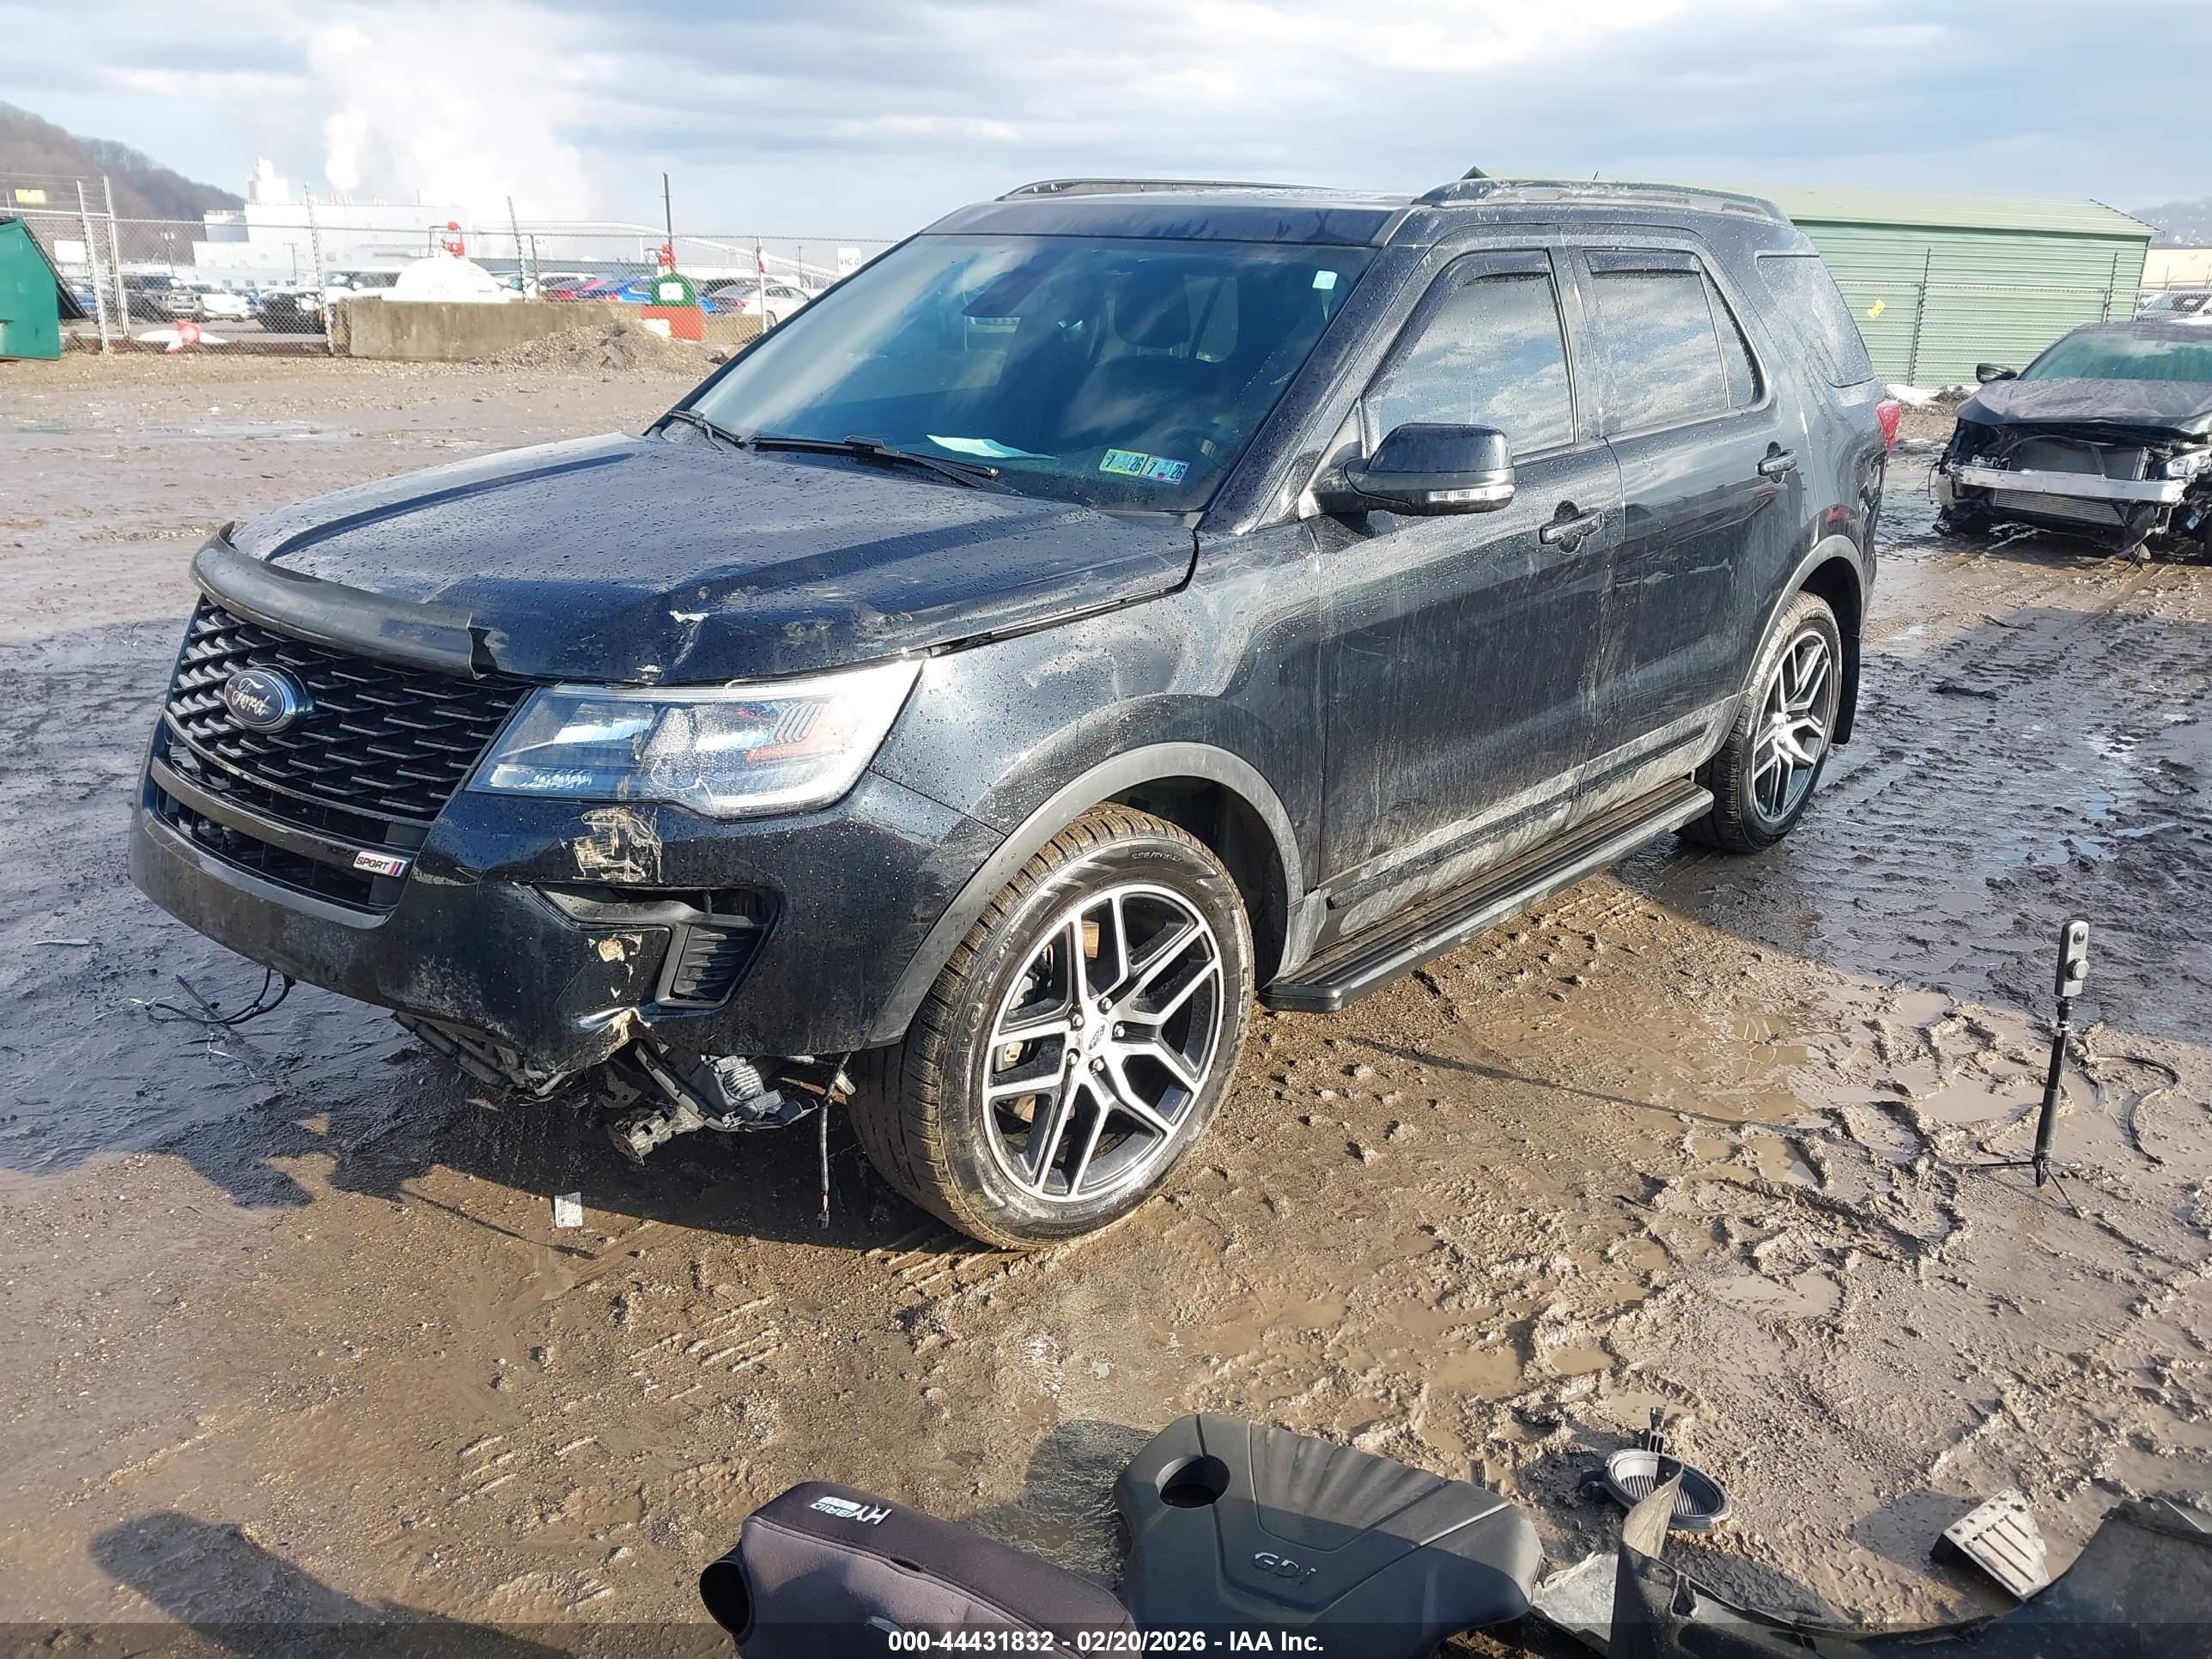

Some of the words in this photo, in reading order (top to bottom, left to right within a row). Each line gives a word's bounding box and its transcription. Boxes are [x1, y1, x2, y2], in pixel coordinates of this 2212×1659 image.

[1106, 454, 1116, 468] 7
[1128, 456, 1145, 472] 26
[1146, 461, 1159, 475] 7
[1170, 464, 1186, 480] 26
[231, 677, 272, 716] Ford
[356, 856, 390, 871] SPORT
[809, 1503, 893, 1525] HYBRID
